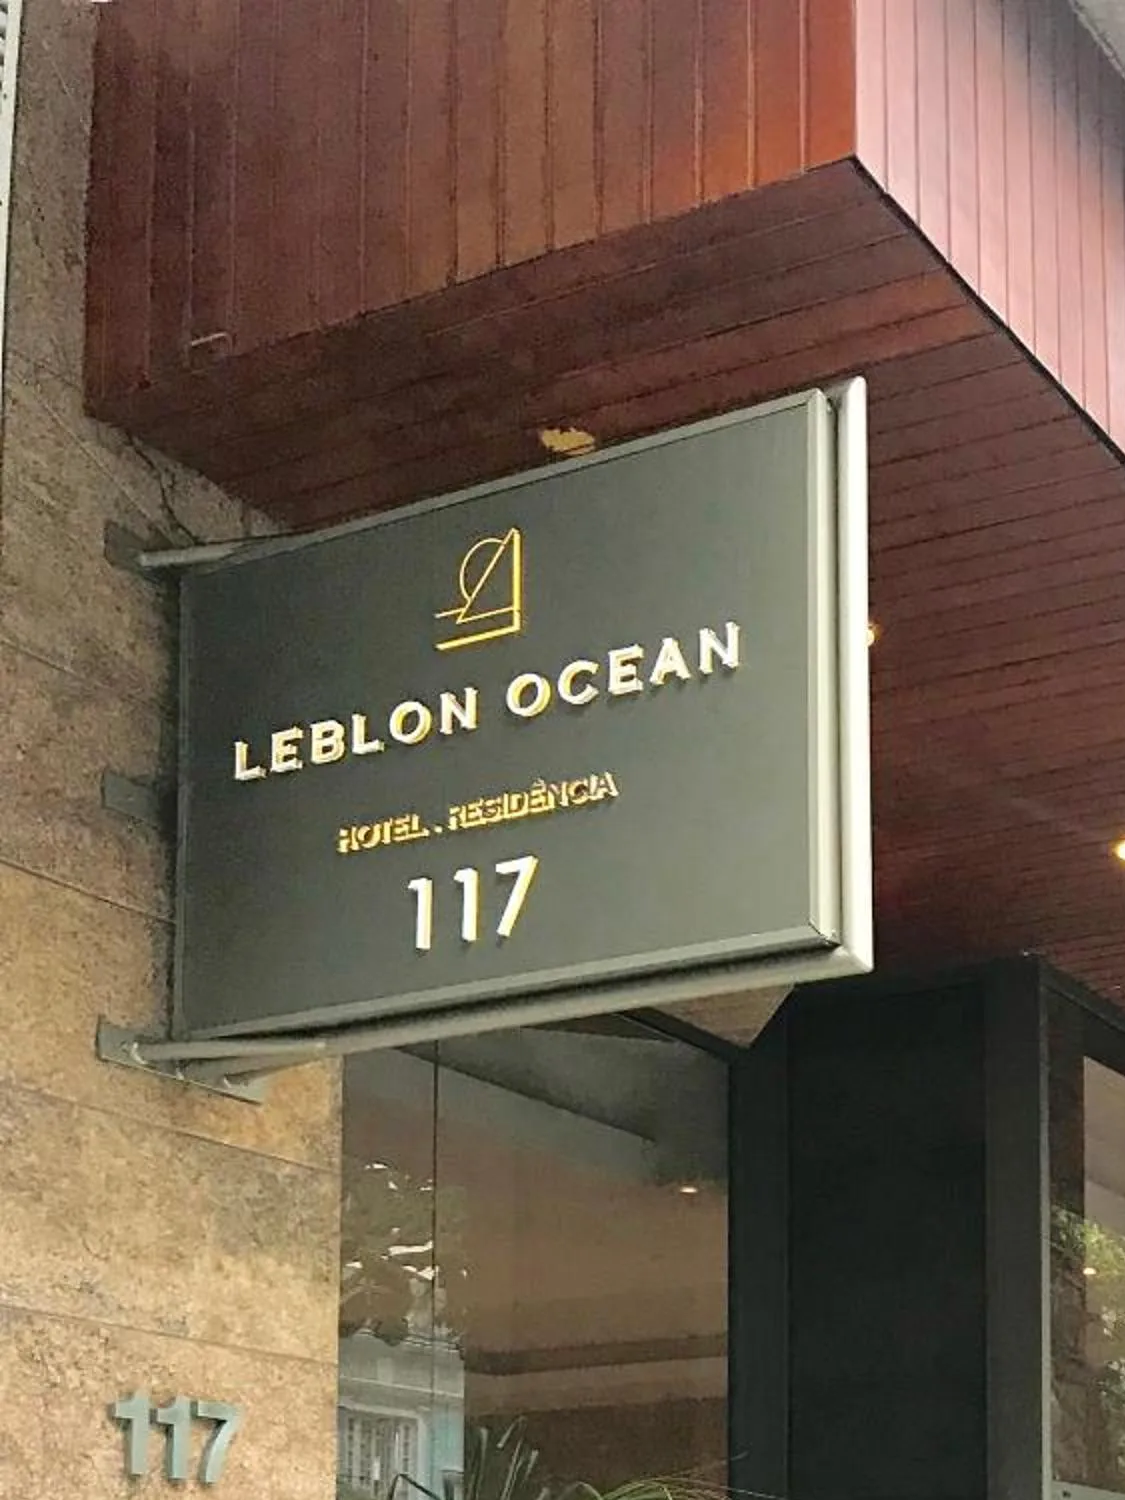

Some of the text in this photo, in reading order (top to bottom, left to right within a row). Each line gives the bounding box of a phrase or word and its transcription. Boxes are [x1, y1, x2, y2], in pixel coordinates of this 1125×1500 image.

[233, 620, 742, 782] LEBLON OCEAN
[336, 812, 431, 853] HOTEL
[448, 771, 620, 831] RESIDÊNCIA
[407, 854, 539, 951] 117
[110, 1388, 243, 1485] 117
